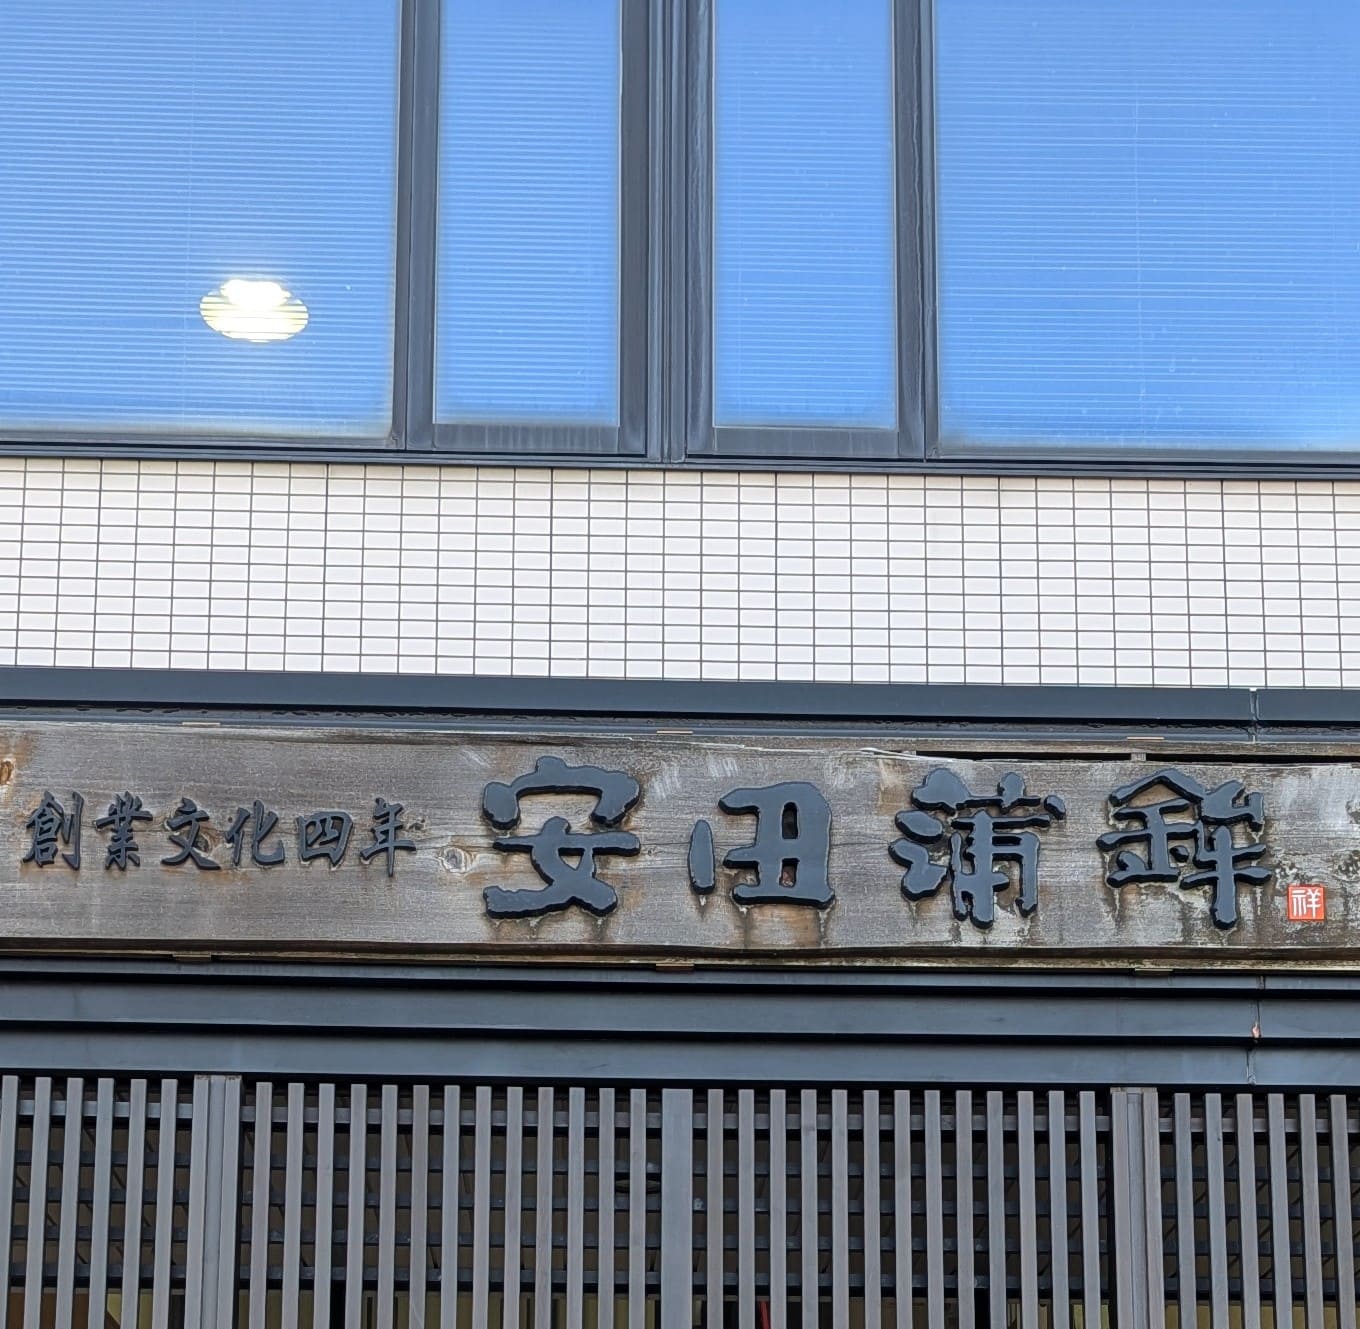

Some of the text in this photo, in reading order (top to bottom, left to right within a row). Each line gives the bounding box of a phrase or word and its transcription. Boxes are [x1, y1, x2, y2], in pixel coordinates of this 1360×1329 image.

[19, 788, 418, 878] 創業文化四年
[482, 754, 1272, 931] 安田蒲鉾
